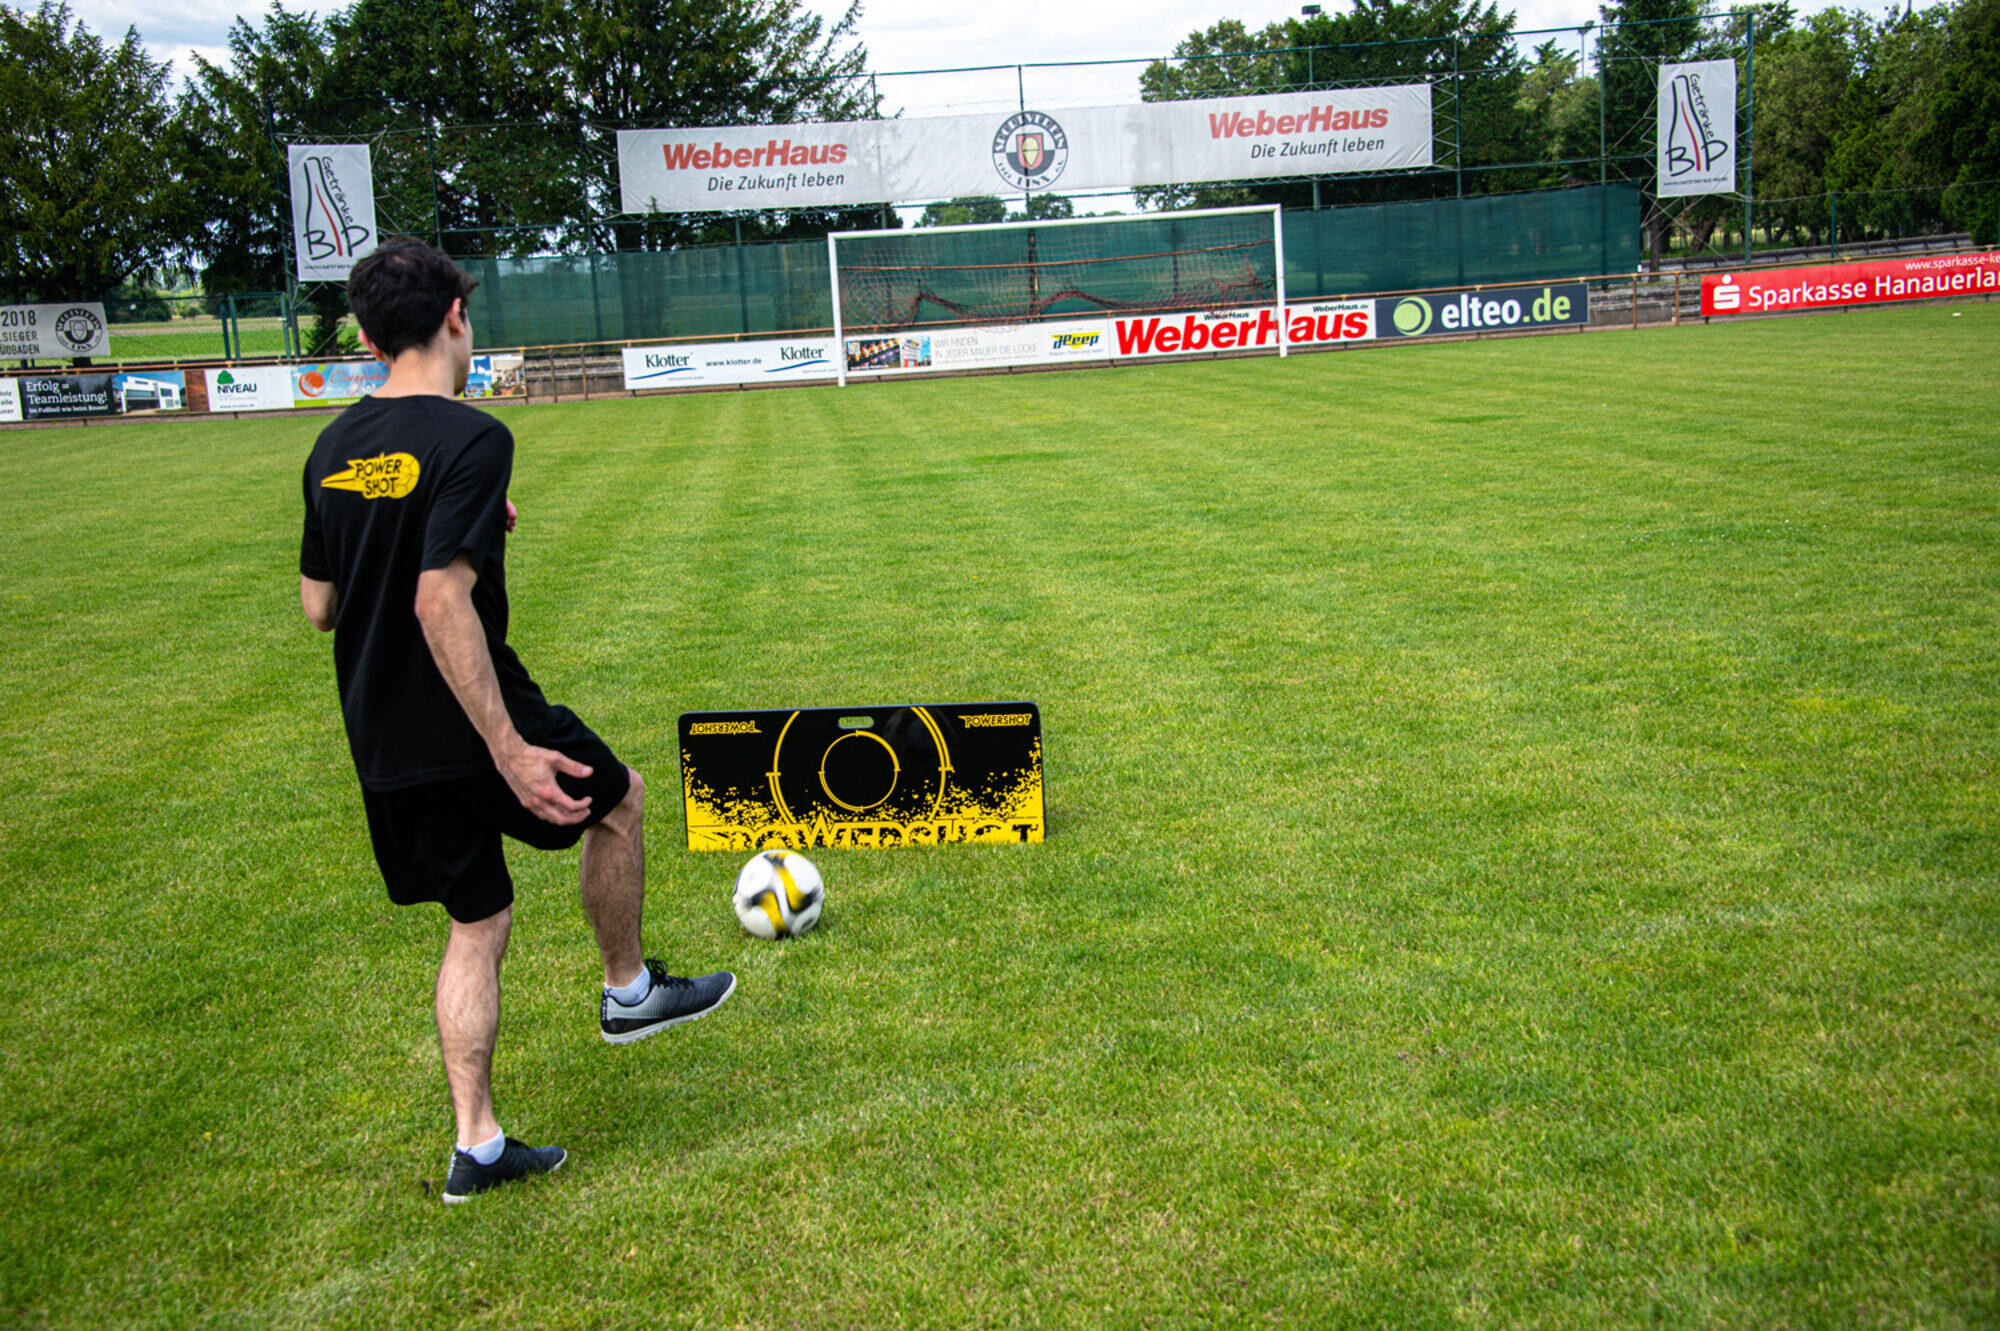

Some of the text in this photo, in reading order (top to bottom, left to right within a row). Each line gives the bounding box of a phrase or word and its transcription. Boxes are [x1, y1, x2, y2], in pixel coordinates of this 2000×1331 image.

[1209, 105, 1390, 139] WeberHaus
[662, 139, 848, 171] WeberHaus
[1250, 137, 1385, 158] Die Zukunft leben
[707, 171, 844, 192] Die Zukunft leben
[1748, 281, 1867, 311] Sparkasse
[1441, 288, 1571, 329] elteo.de
[0, 310, 37, 327] 2018
[0, 331, 38, 342] SIEGER
[1115, 308, 1369, 355] WeberHaus
[645, 353, 690, 369] Klotter
[705, 357, 762, 367] www.klotter.de
[780, 346, 825, 361] Klotter
[25, 380, 60, 394] Erfolg
[217, 383, 257, 394] NIVEAU
[26, 390, 108, 405] Teamleistung!
[354, 458, 402, 478] POWER
[364, 476, 400, 495] SHOT
[958, 713, 1032, 728] POWERSHOT
